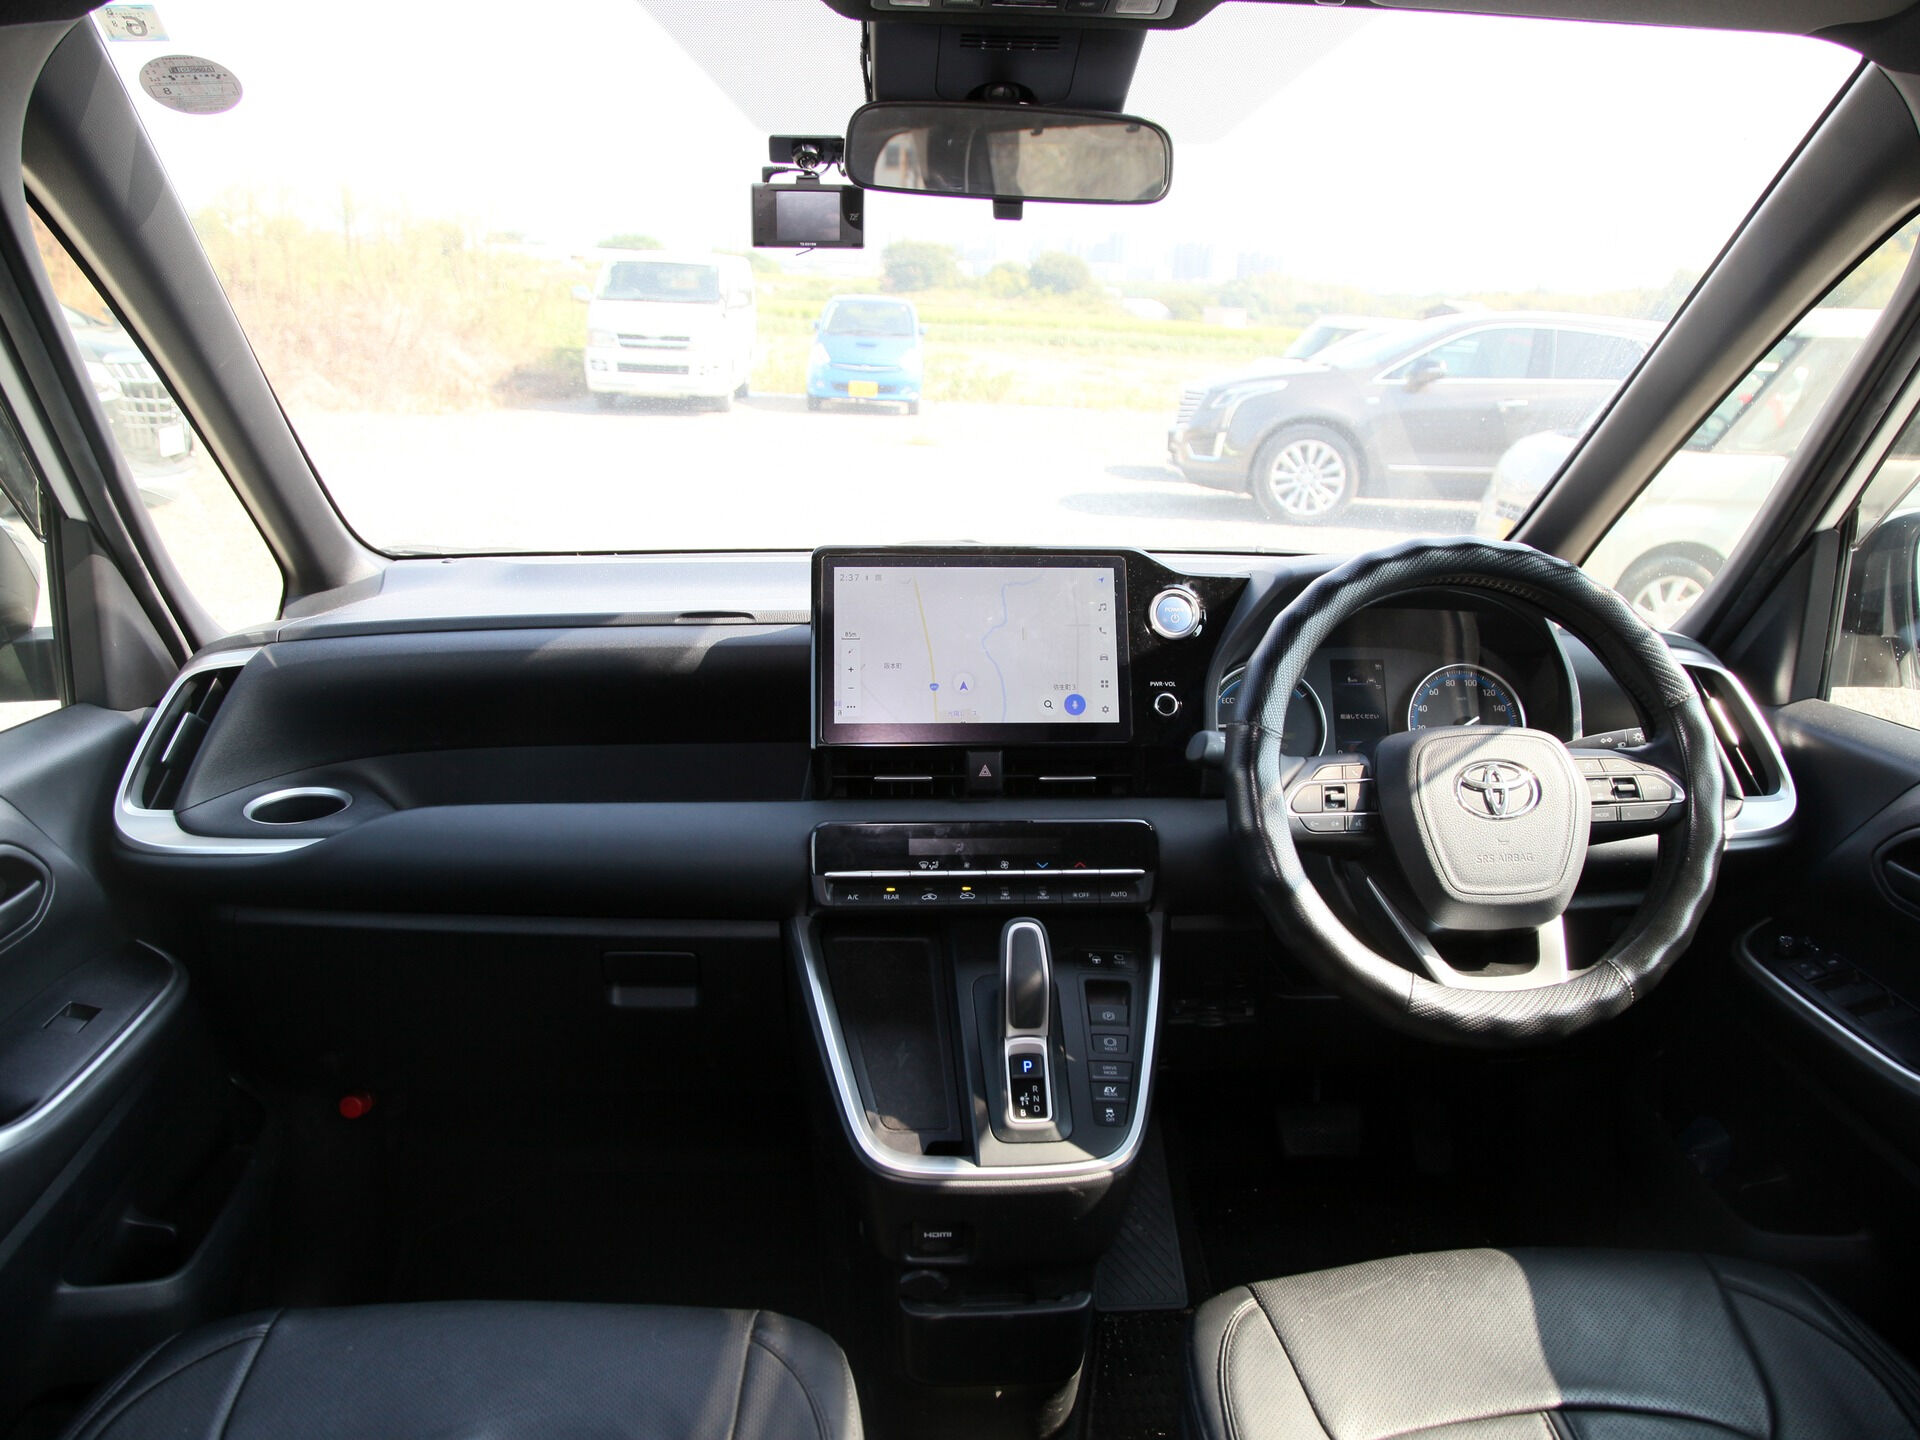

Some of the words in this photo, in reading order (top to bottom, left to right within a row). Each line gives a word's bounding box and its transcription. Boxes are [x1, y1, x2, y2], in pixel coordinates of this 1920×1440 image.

[1445, 679, 1456, 687] 80
[1464, 679, 1478, 687] 100
[1482, 689, 1497, 697] 120
[1417, 704, 1428, 712] 40
[1492, 704, 1506, 712] 140
[1476, 854, 1495, 863] SRS
[1499, 852, 1534, 862] AIRBAG
[1110, 890, 1128, 898] AUTO
[1023, 1060, 1033, 1073] P
[1020, 1108, 1027, 1117] B
[1033, 1105, 1041, 1113] D
